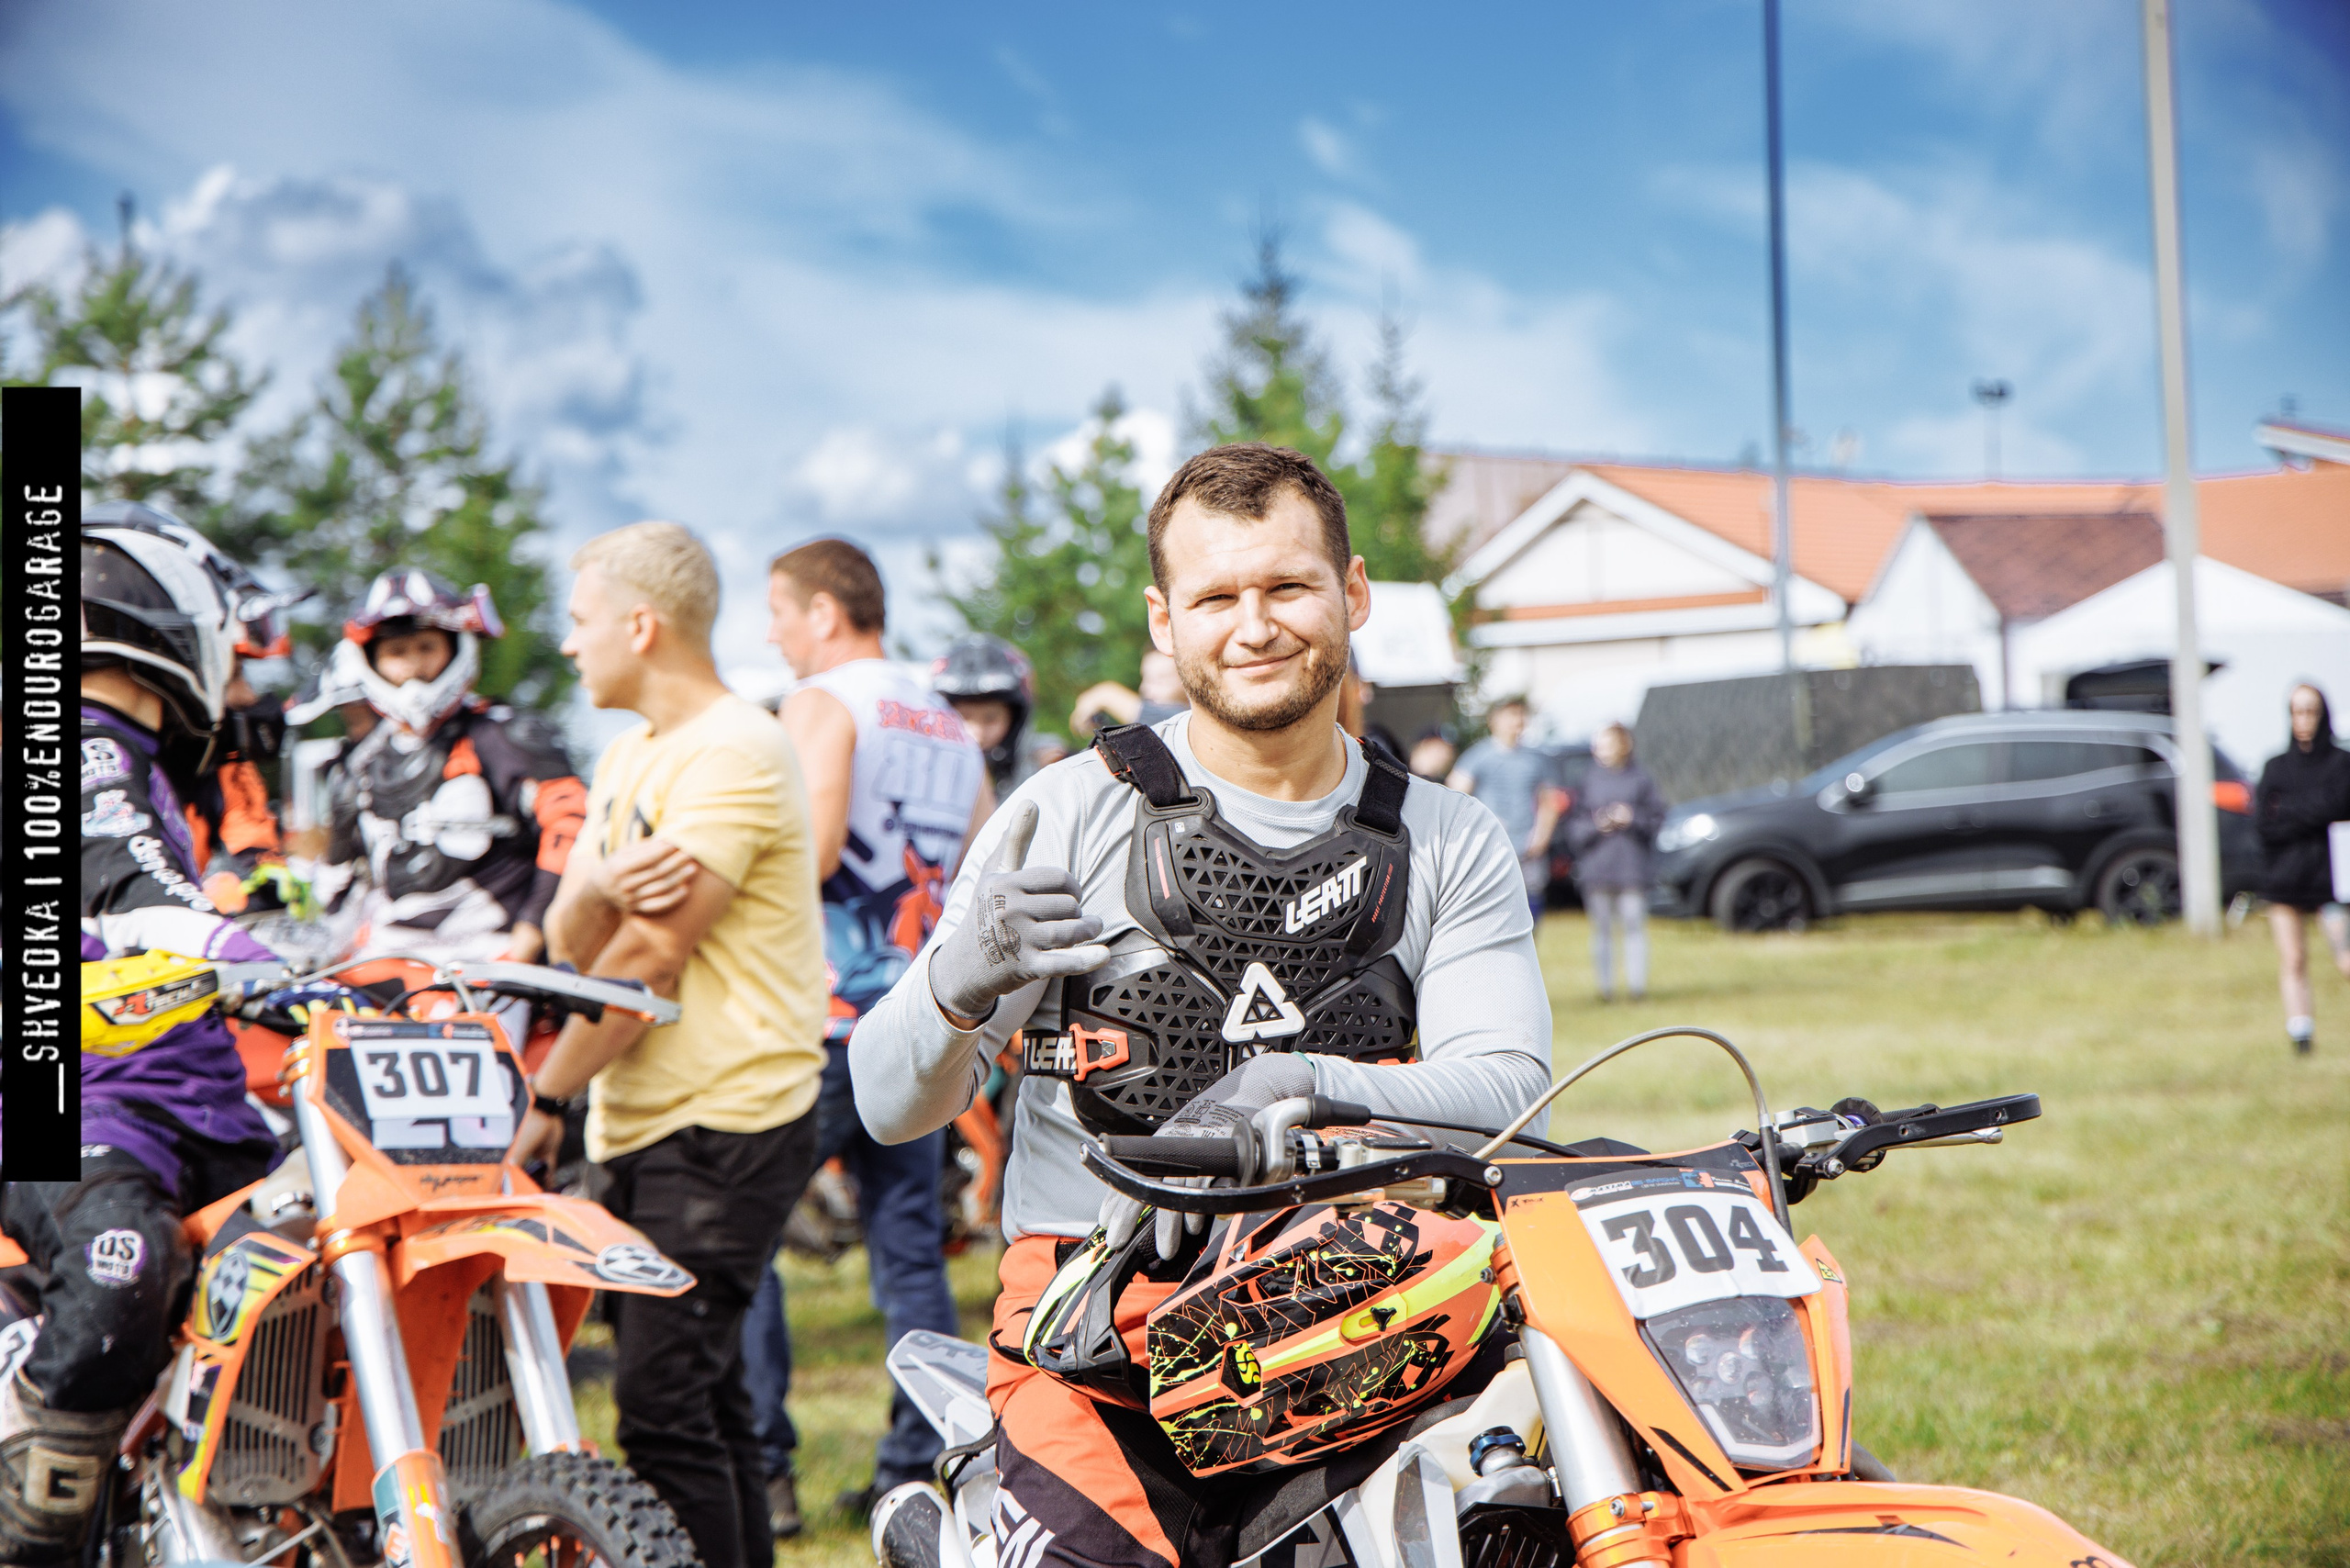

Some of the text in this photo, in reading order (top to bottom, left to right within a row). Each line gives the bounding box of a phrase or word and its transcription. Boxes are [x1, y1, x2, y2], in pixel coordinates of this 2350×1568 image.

[1285, 856, 1367, 934] LEATT
[365, 1052, 480, 1098] 307
[1030, 1037, 1078, 1070] LEA
[1600, 1204, 1790, 1289] 304
